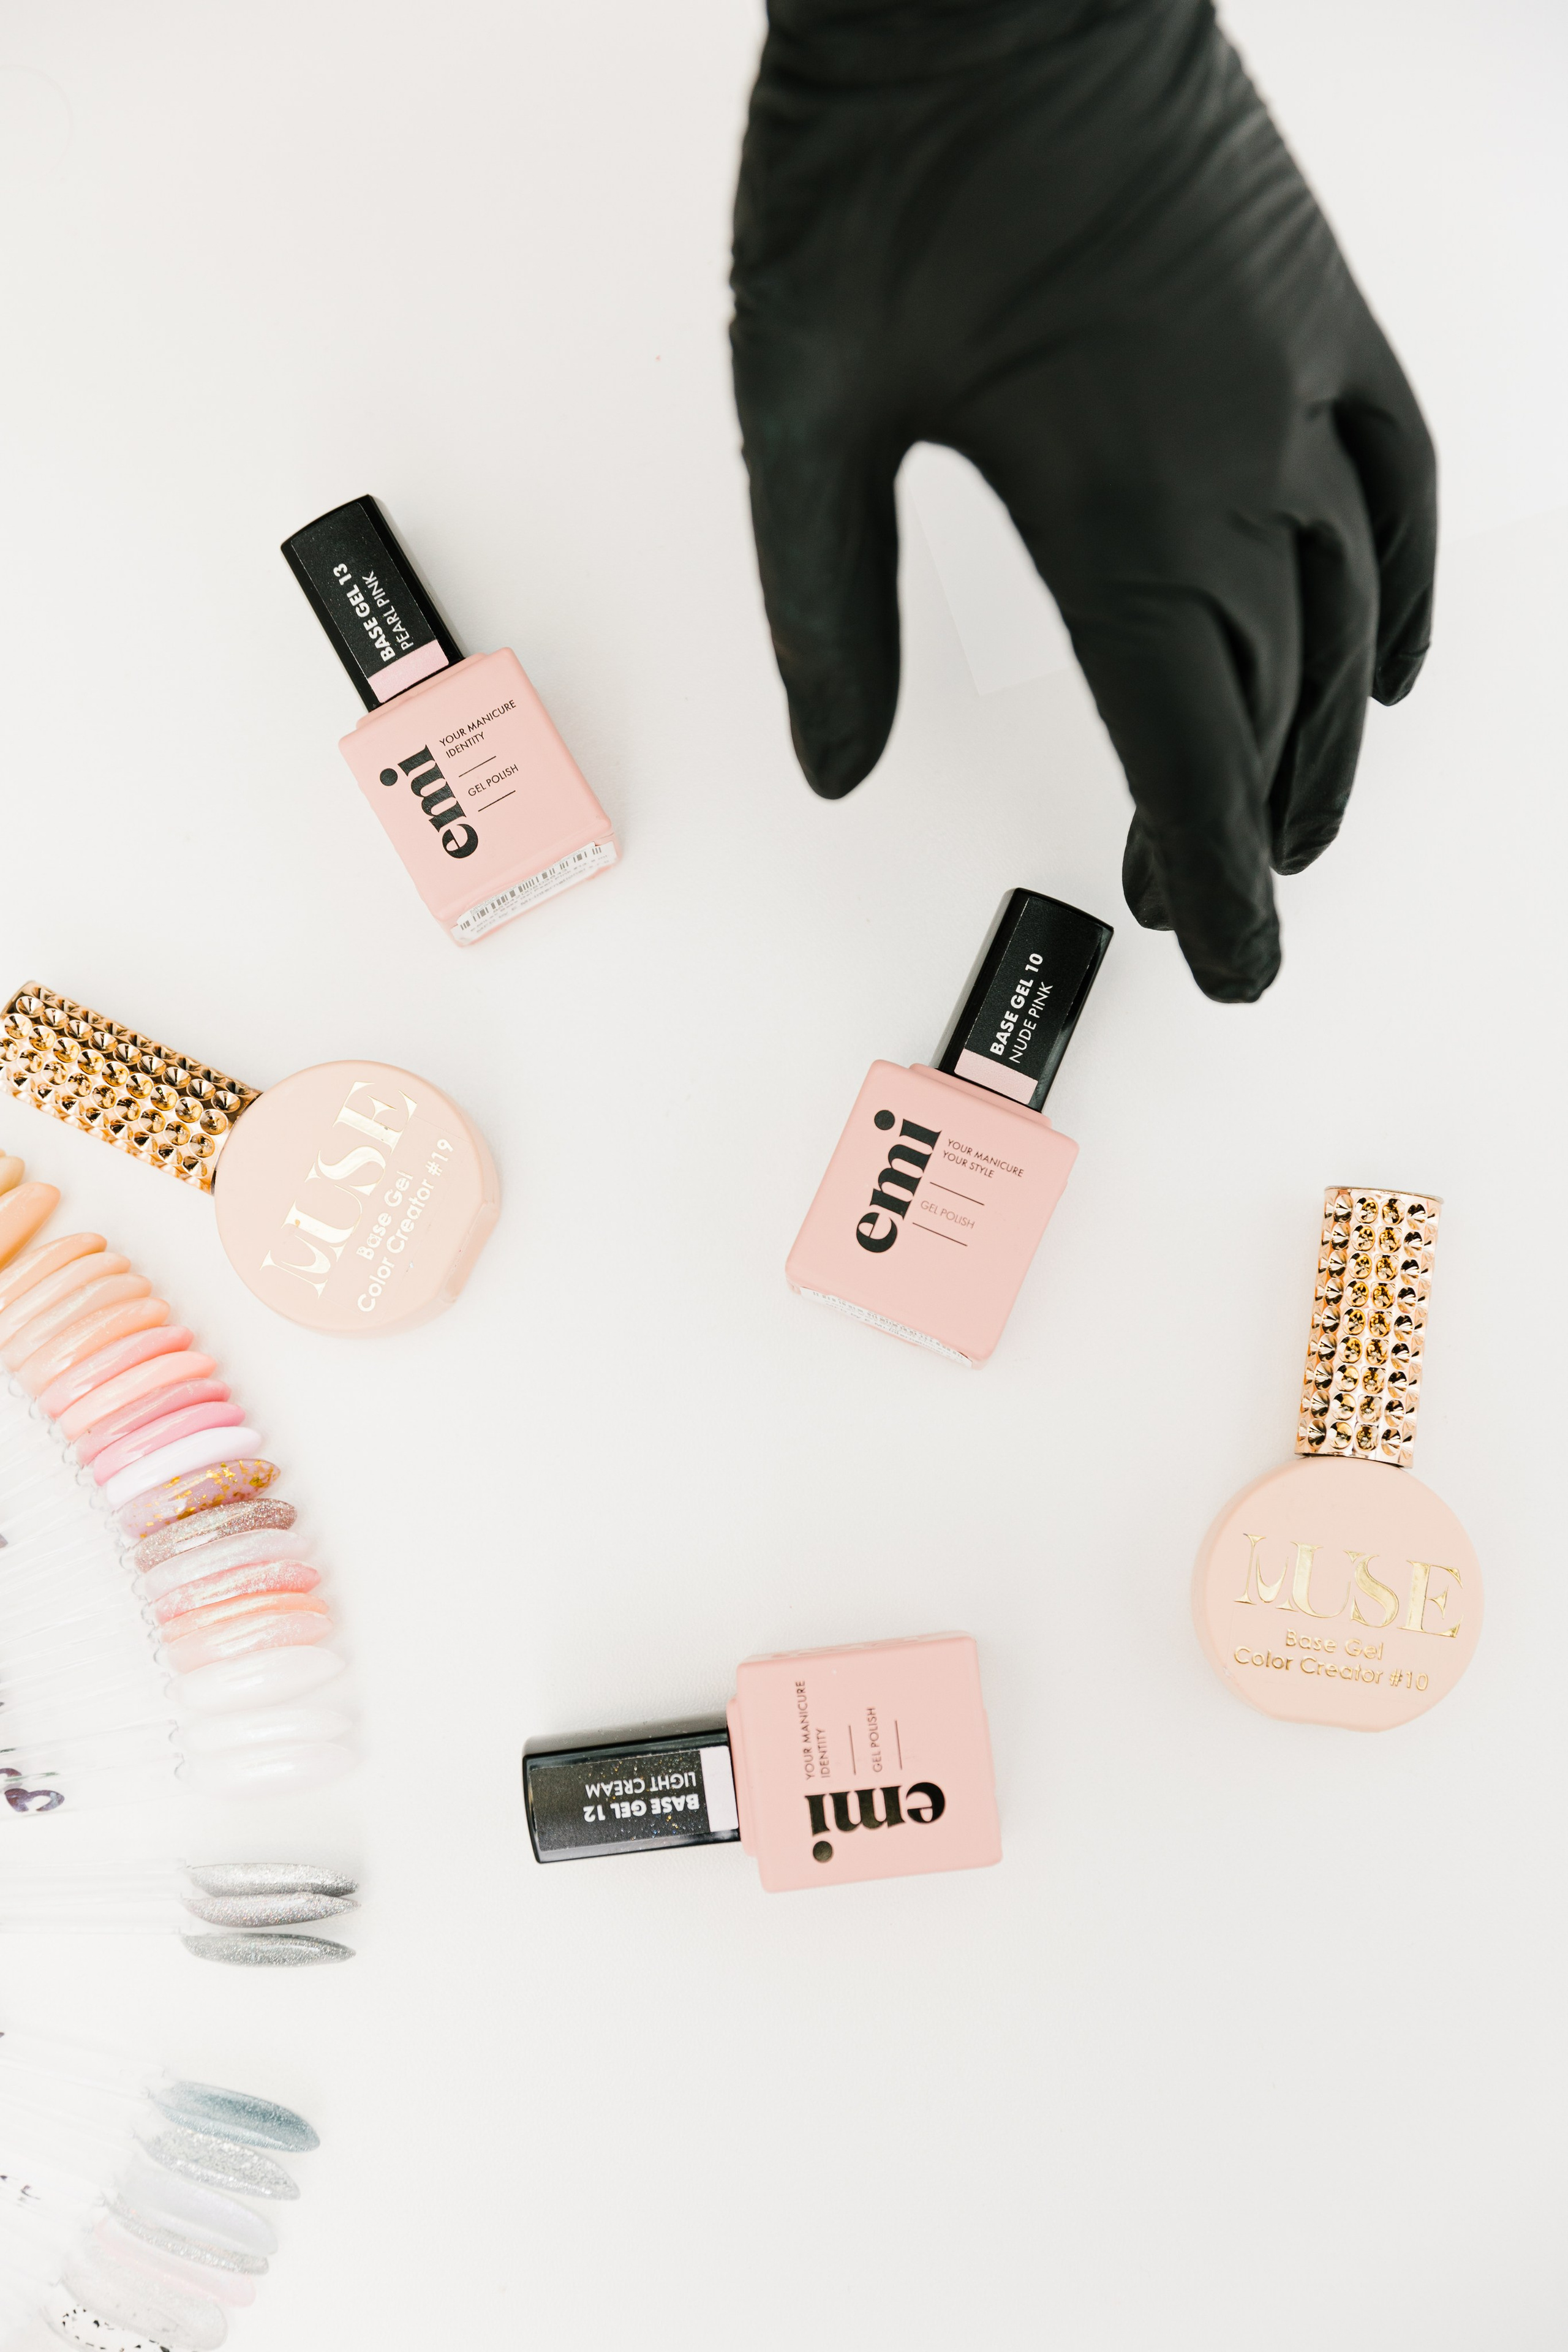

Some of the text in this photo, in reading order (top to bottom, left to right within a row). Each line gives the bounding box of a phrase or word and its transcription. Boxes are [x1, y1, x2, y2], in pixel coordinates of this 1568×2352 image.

[333, 564, 395, 662] BASE GEL 13
[362, 570, 413, 650] PEARL PINK
[439, 700, 516, 746] YOUR MANICURE
[446, 732, 484, 758] IDENTITY
[380, 745, 478, 859] emi
[469, 764, 518, 796] GEL POLISH
[990, 954, 1043, 1055] BASE GEL 10
[1009, 982, 1053, 1063] NUDE PINK
[260, 1080, 418, 1298] MUSE
[856, 1110, 941, 1253] emi
[943, 1150, 994, 1178] YOUR STYLE
[948, 1139, 1023, 1177] YOUR MANICURE
[356, 1170, 413, 1260] Base Gel
[358, 1139, 453, 1311] Color Creator #19
[921, 1200, 975, 1229] GEL POLISH
[1234, 1533, 1463, 1639] MUSE
[1234, 1646, 1428, 1691] Color Creator #10
[1286, 1629, 1384, 1660] Base Gel
[796, 1681, 815, 1780] YOUR MANICURE
[816, 1729, 830, 1777] IDENTITY
[867, 1708, 883, 1773] GEL POLISH
[583, 1793, 699, 1822] BASE GEL 12
[585, 1770, 696, 1799] LIGHT CREAM
[805, 1782, 946, 1863] emi
